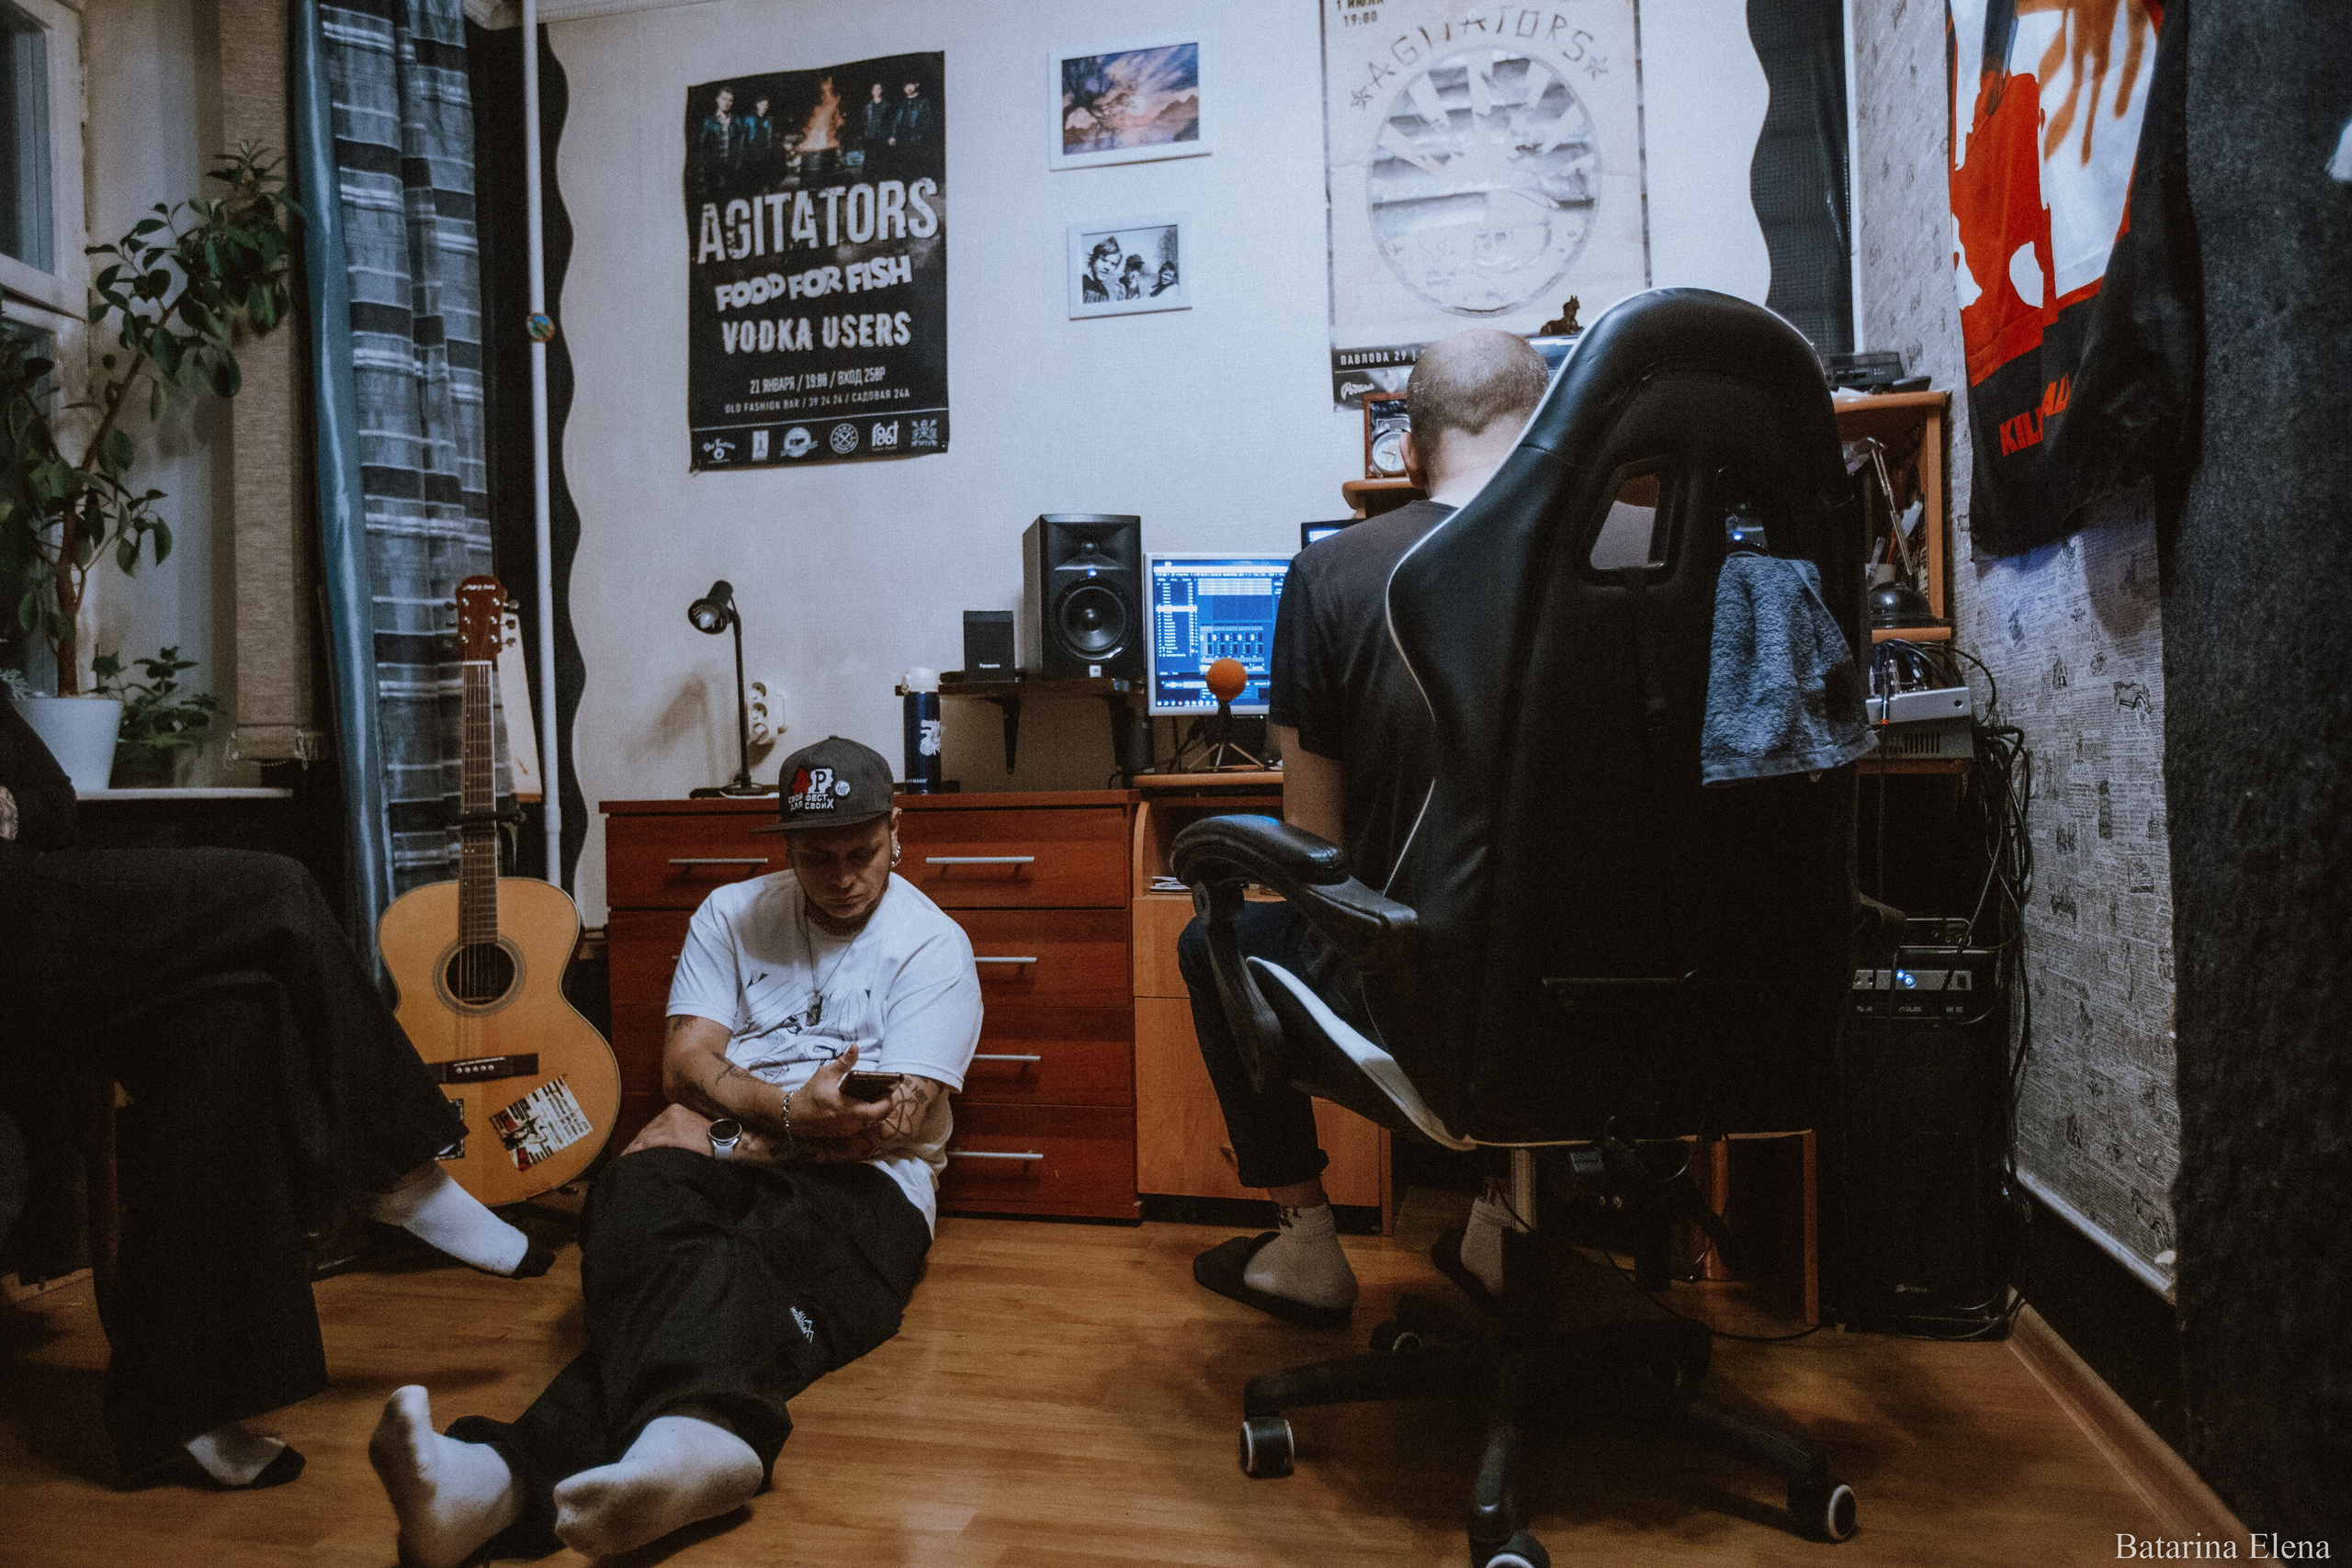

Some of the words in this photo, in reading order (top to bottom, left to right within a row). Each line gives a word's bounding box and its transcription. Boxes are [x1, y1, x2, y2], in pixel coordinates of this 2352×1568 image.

[1344, 11, 1378, 28] 19:00
[697, 177, 939, 265] AGITATORS
[715, 273, 787, 312] FOOD
[787, 265, 844, 300] FOR
[845, 255, 912, 294] FISH
[721, 317, 814, 355] VODKA
[821, 310, 912, 349] USERS
[1340, 351, 1390, 366] ПАВЛОВА
[1394, 349, 1408, 362] 29
[750, 378, 760, 395] 21
[762, 375, 796, 394] ЯНВАРЯ
[837, 368, 863, 387] ВХОД
[724, 402, 741, 414] OLD
[743, 400, 781, 412] FASHION
[783, 399, 800, 411] BAR
[851, 389, 891, 403] САДОВАЯ
[787, 792, 803, 804] СВОЙ
[805, 794, 829, 802] ФЕСТ
[790, 800, 803, 811] ДЛЯ
[804, 798, 834, 809] СВОИХ
